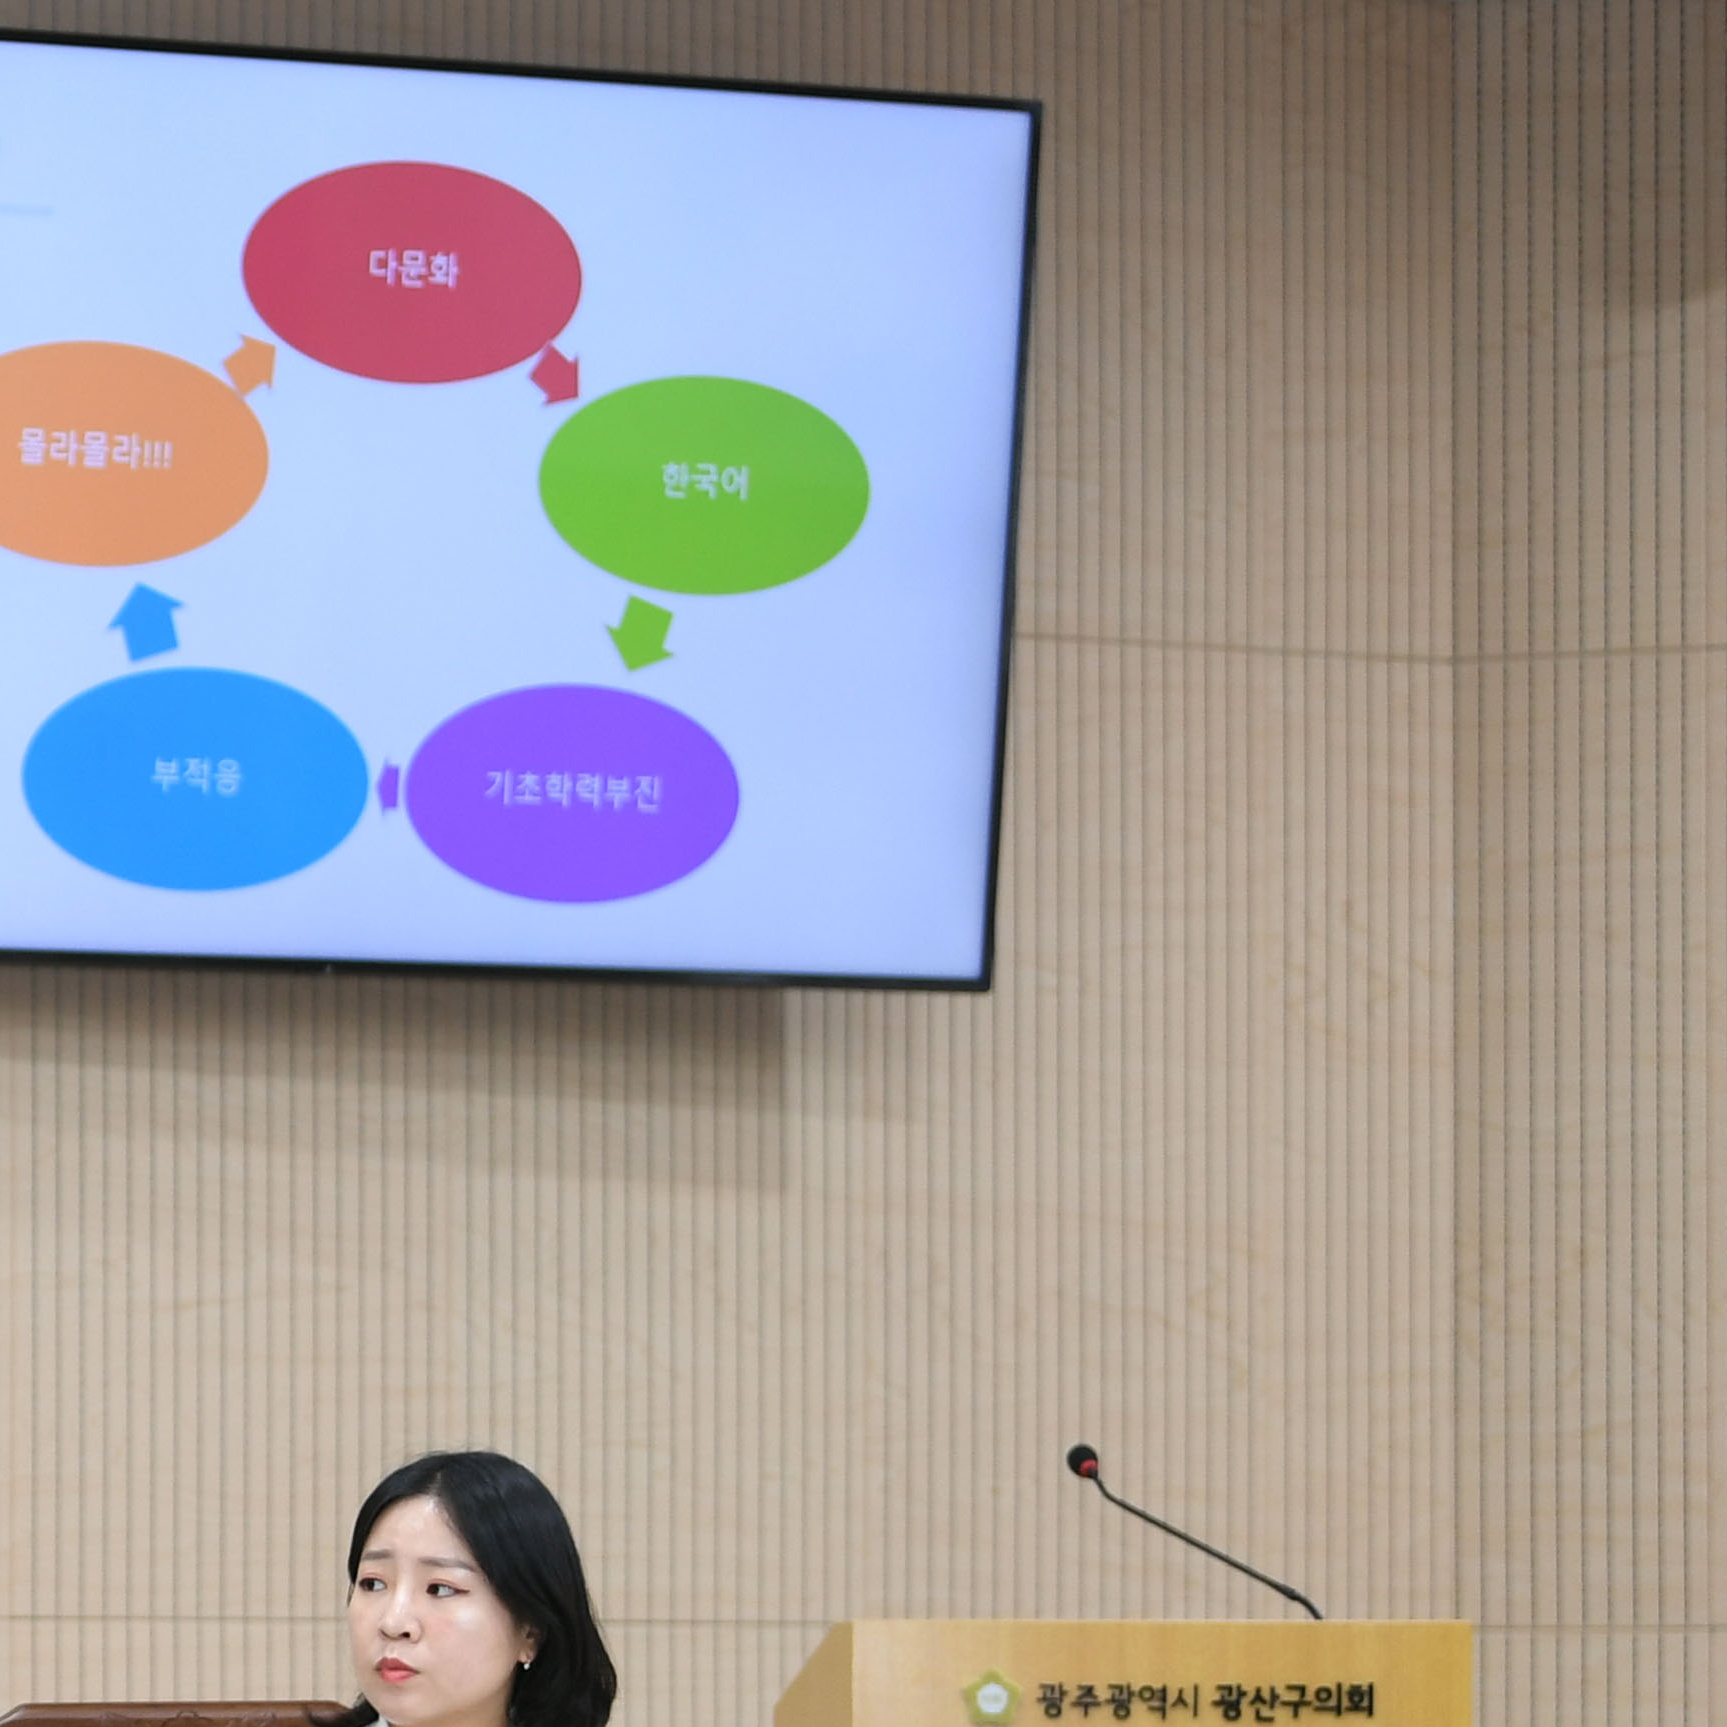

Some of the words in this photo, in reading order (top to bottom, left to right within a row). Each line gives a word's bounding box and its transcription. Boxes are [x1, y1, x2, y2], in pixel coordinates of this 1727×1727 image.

[368, 248, 460, 289] 다문화
[661, 460, 751, 502] 한국어
[151, 757, 243, 796] 부적응
[484, 769, 661, 813] 기초학력부진
[1036, 1682, 1200, 1722] 광주광역시
[1211, 1678, 1375, 1724] 광산구의회
